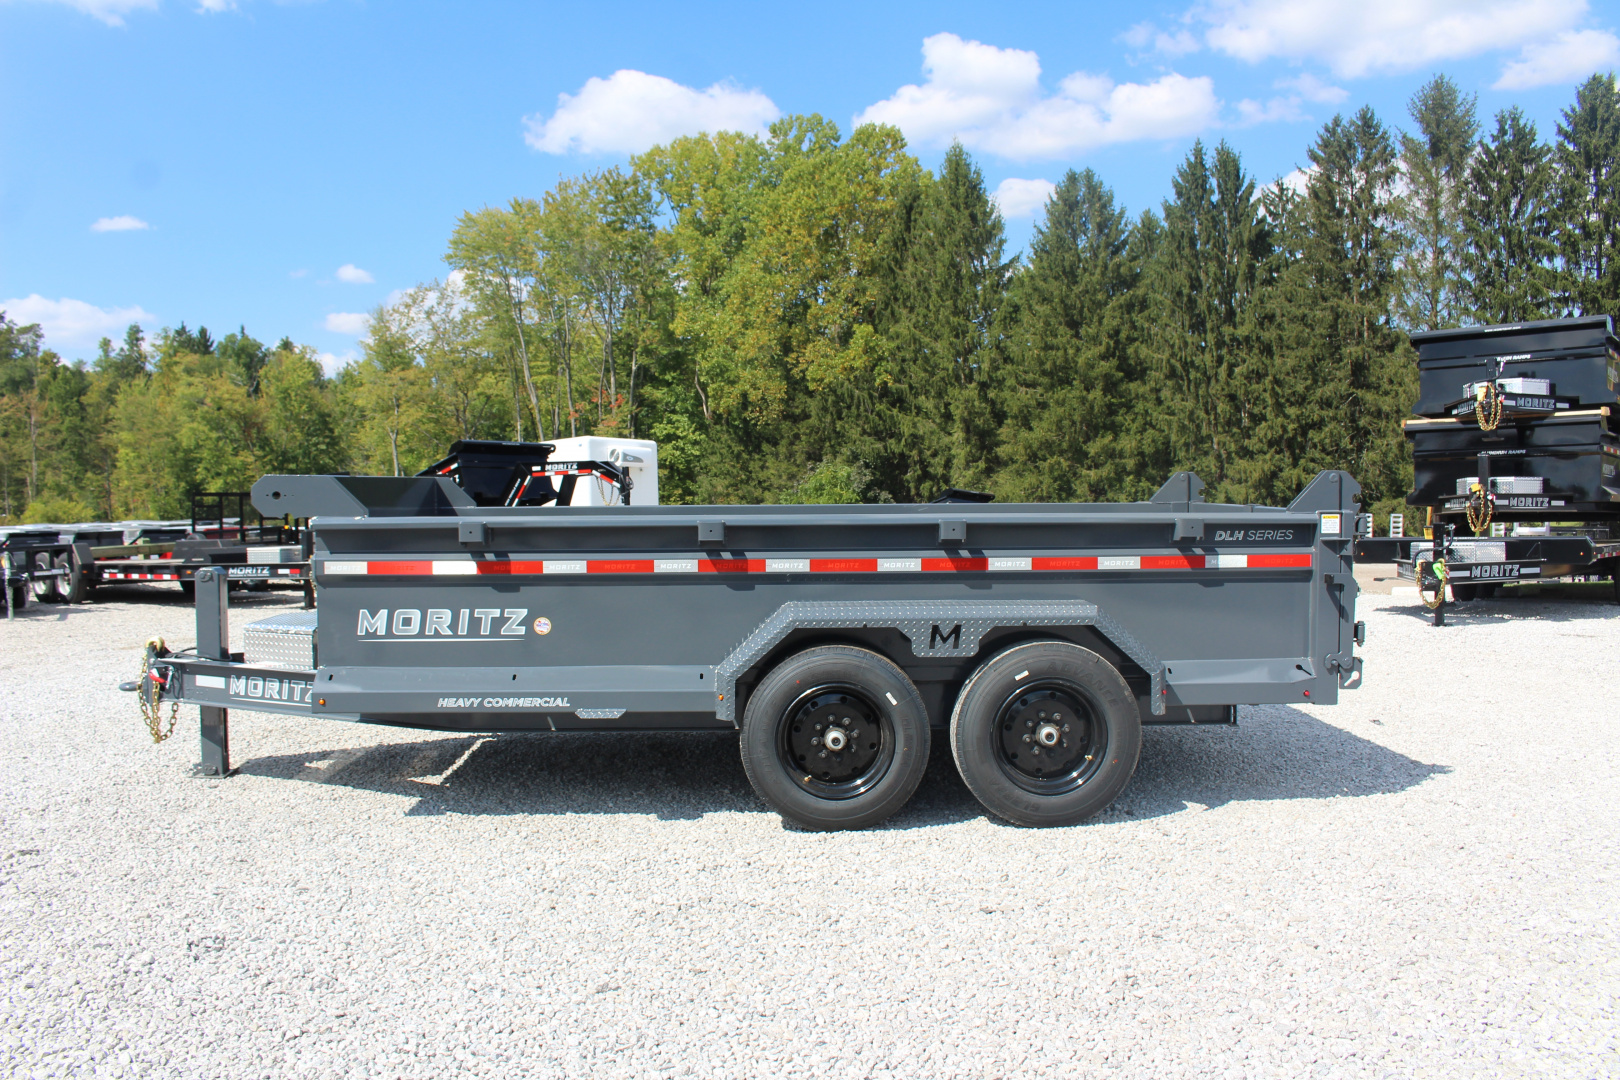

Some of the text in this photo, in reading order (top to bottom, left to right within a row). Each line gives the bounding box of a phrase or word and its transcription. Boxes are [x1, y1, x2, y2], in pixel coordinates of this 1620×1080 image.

[1517, 397, 1555, 409] MORITZ
[545, 462, 578, 471] MORITZ
[1509, 497, 1549, 507] MORITZ
[1215, 529, 1294, 541] DLH SERIES
[228, 566, 270, 575] MORITZ
[1472, 564, 1520, 578] MORITZ
[356, 608, 528, 636] MORITZ
[928, 624, 962, 650] M
[437, 697, 571, 708] HEAVY COMMERCIAL
